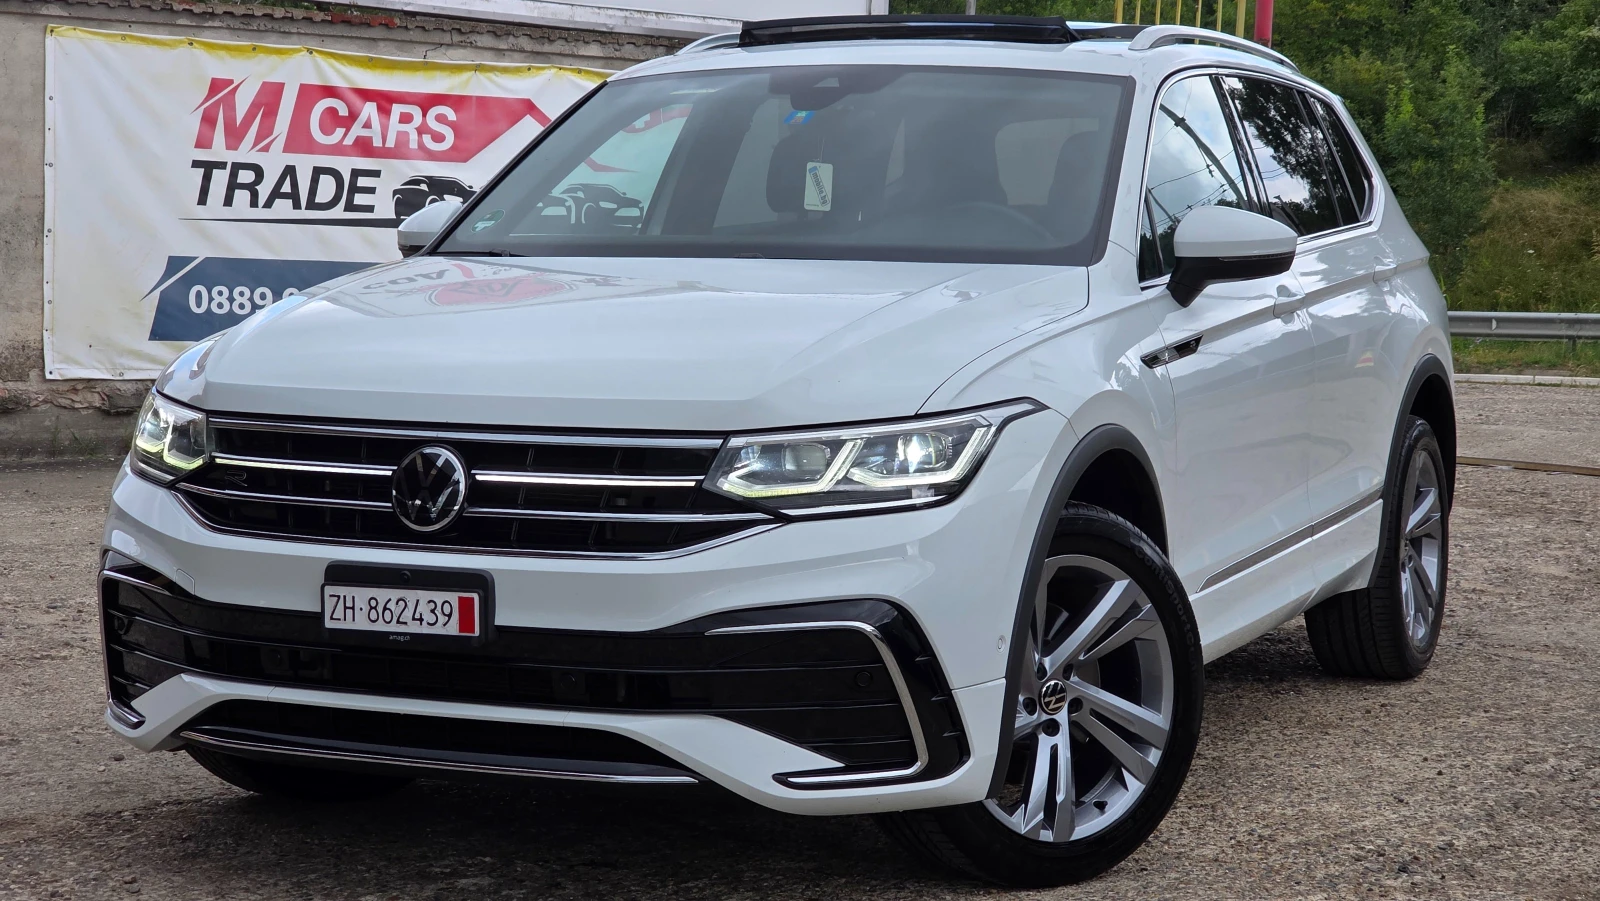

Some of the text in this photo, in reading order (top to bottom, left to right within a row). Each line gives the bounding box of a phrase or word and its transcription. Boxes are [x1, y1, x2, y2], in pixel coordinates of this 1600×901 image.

[191, 76, 457, 154] M CARS
[191, 159, 382, 214] TRADE
[811, 171, 829, 205] mobile.bg
[188, 284, 274, 315] 0889
